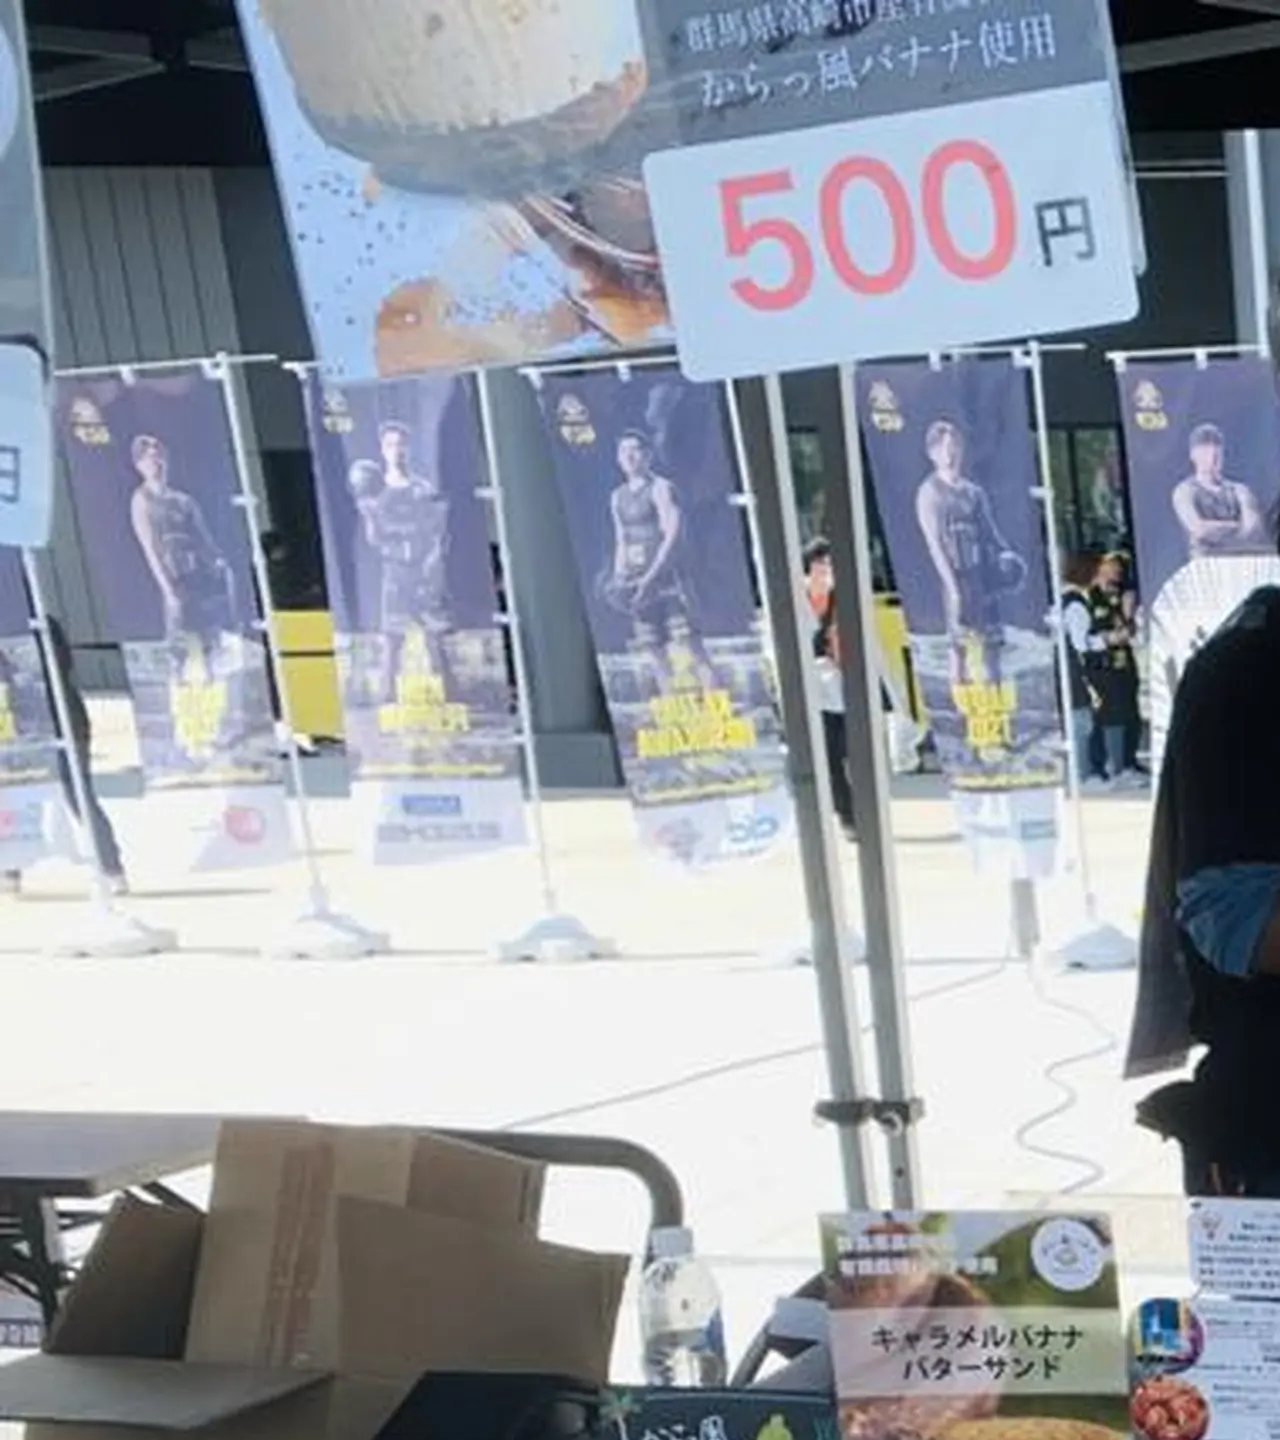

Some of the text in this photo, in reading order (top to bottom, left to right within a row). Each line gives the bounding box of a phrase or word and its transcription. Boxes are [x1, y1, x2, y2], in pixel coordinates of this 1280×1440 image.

[701, 12, 1056, 108] からっ風バナナ使用
[870, 1324, 1085, 1353] キャラメルバナナ
[903, 1354, 1063, 1382] バターサンド
